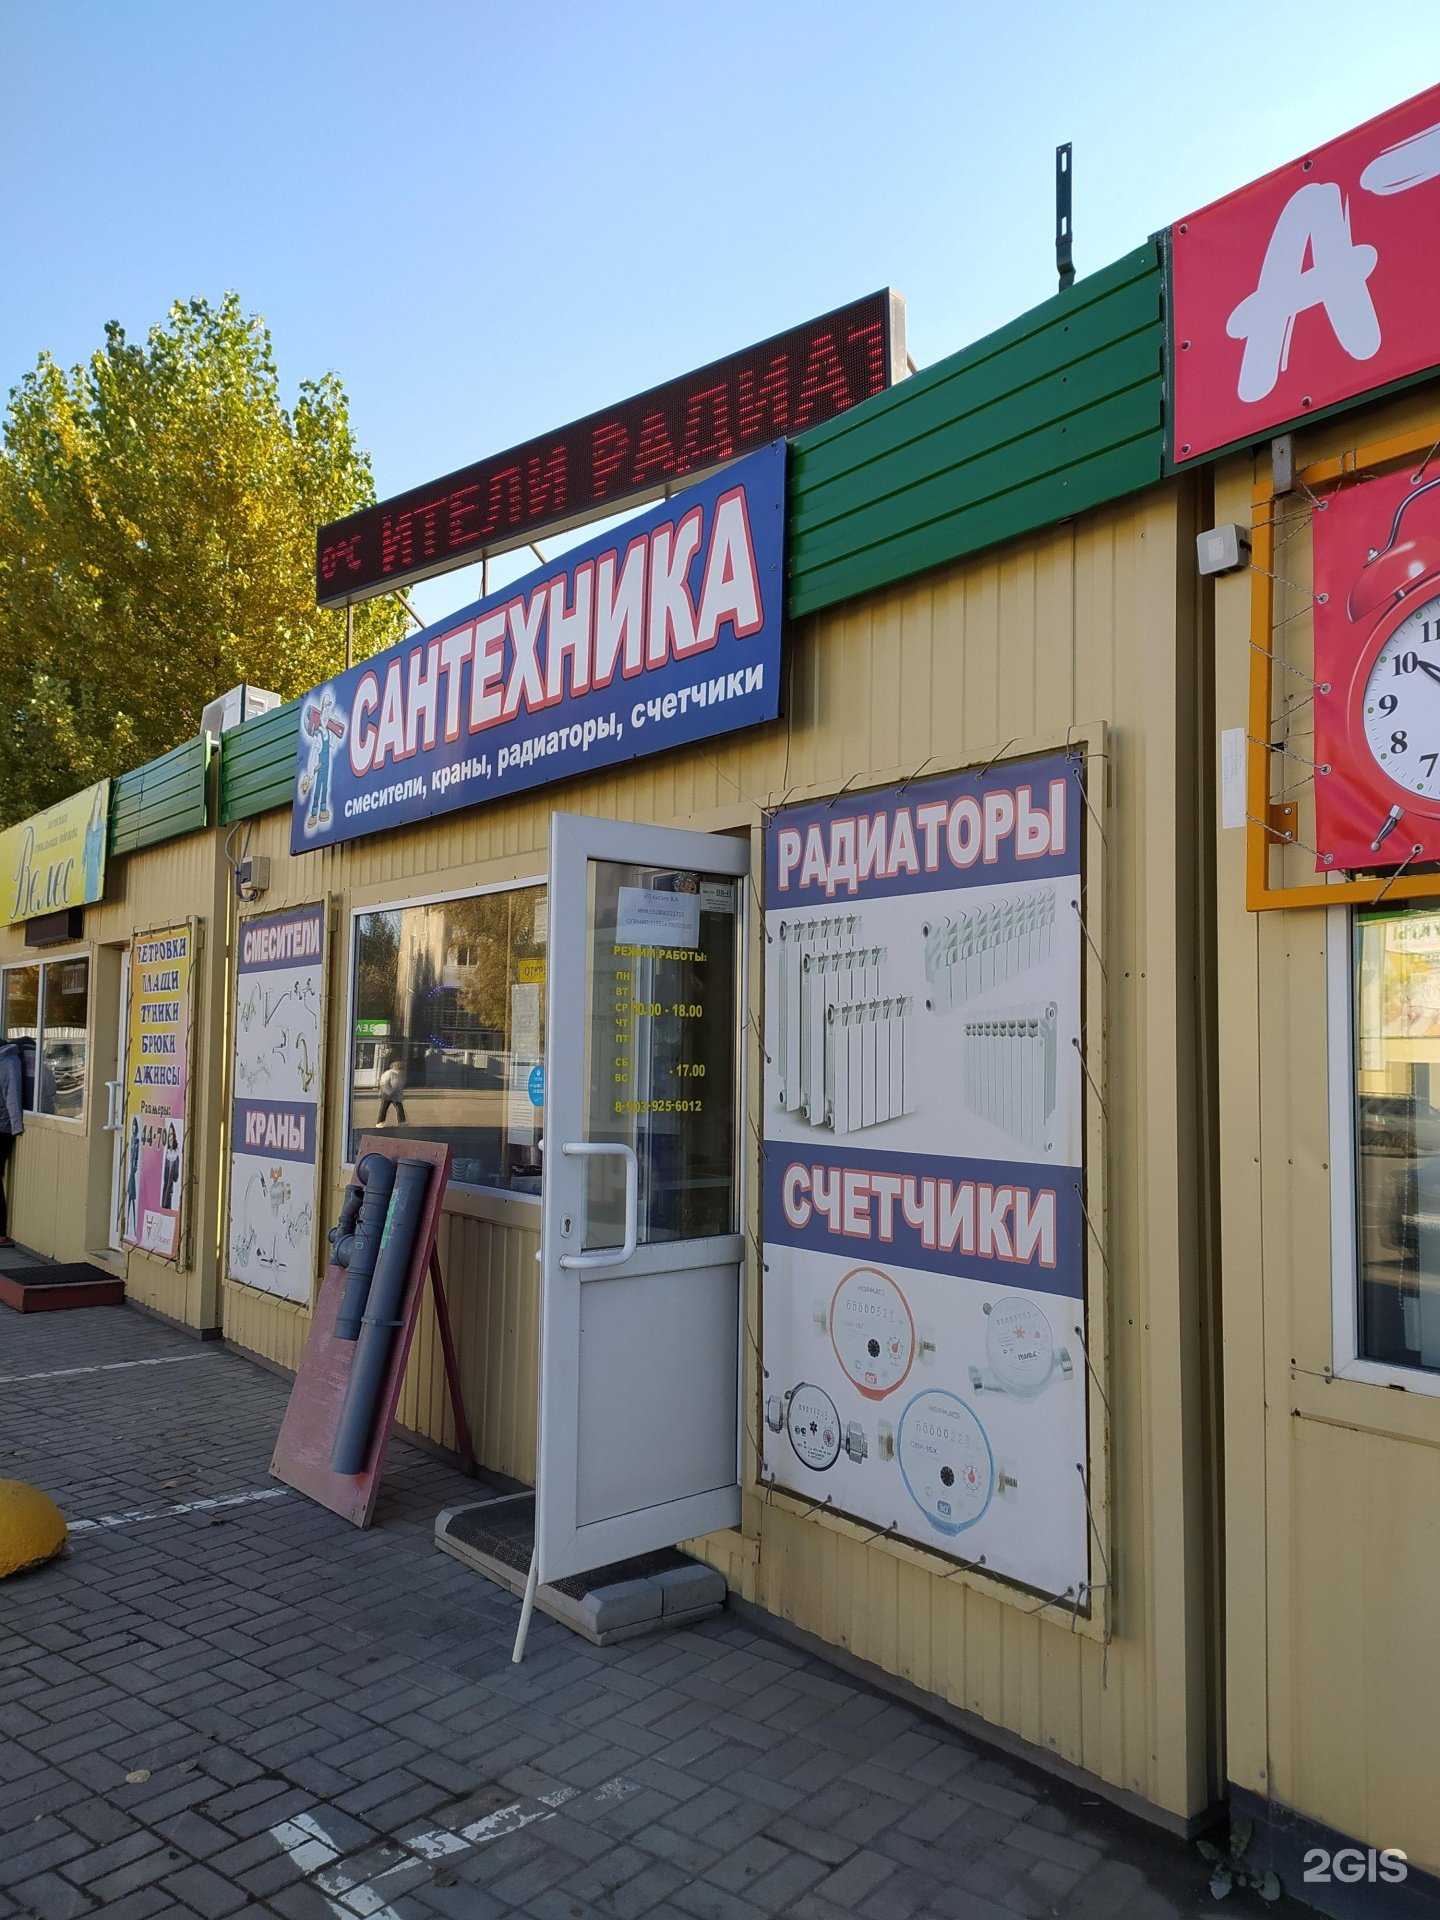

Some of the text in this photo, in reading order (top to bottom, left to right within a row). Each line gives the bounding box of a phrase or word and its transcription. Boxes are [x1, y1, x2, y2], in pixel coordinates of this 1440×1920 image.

[349, 485, 765, 777] САНТЕХНИКА
[1391, 651, 1419, 677] 10
[1378, 694, 1399, 719] 9
[344, 663, 764, 818] смесители, краны, радиаторы, счетчики
[1390, 730, 1409, 754] 8
[1418, 752, 1439, 778] 7
[777, 779, 1068, 896] РАДИАТОРЫ
[243, 919, 320, 964] СМЕСИТЕЛИ
[615, 971, 630, 981] ПН
[615, 987, 629, 996] ВТ
[615, 1003, 629, 1012] СР
[672, 1004, 703, 1018] 18.00
[615, 1018, 629, 1027] ЧТ
[141, 1034, 176, 1054] БРЮКИ
[615, 1034, 629, 1043] ПТ
[615, 1058, 629, 1067] СБ
[676, 1064, 705, 1077] 17.00
[134, 1065, 181, 1086] ДЖИНСЫ
[615, 1073, 629, 1082] ВС
[245, 1111, 306, 1151] КРАНЫ
[782, 1162, 1057, 1269] СЧЕТЧИКИ
